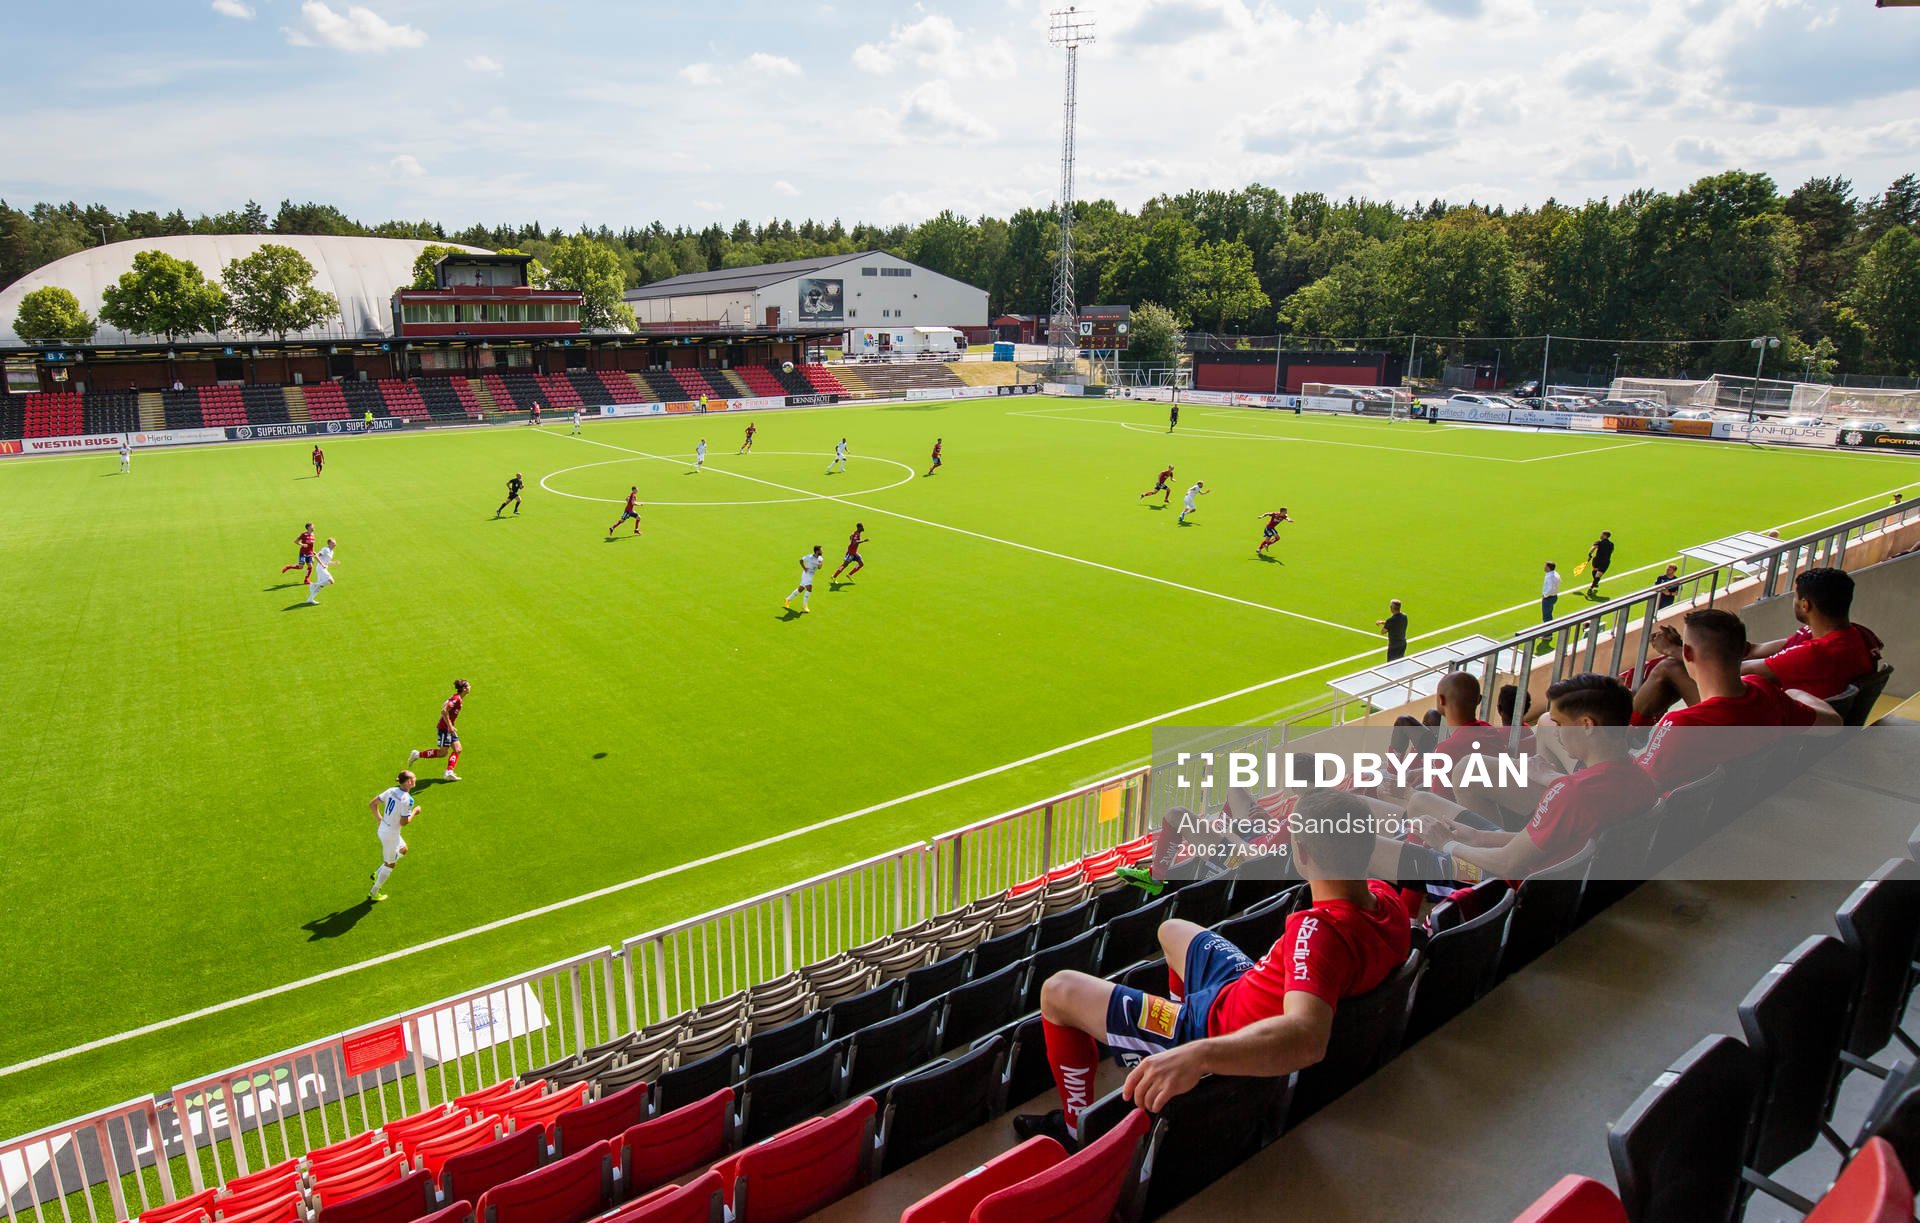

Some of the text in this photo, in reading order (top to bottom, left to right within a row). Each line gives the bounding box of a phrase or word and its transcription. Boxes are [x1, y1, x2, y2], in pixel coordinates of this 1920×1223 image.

[257, 425, 307, 437] SUPERCOACH
[1722, 422, 1826, 438] CLEANHOUSE
[32, 437, 119, 449] WESTIN BUSS
[1293, 915, 1319, 981] stadium
[136, 1072, 326, 1155] UNIBET
